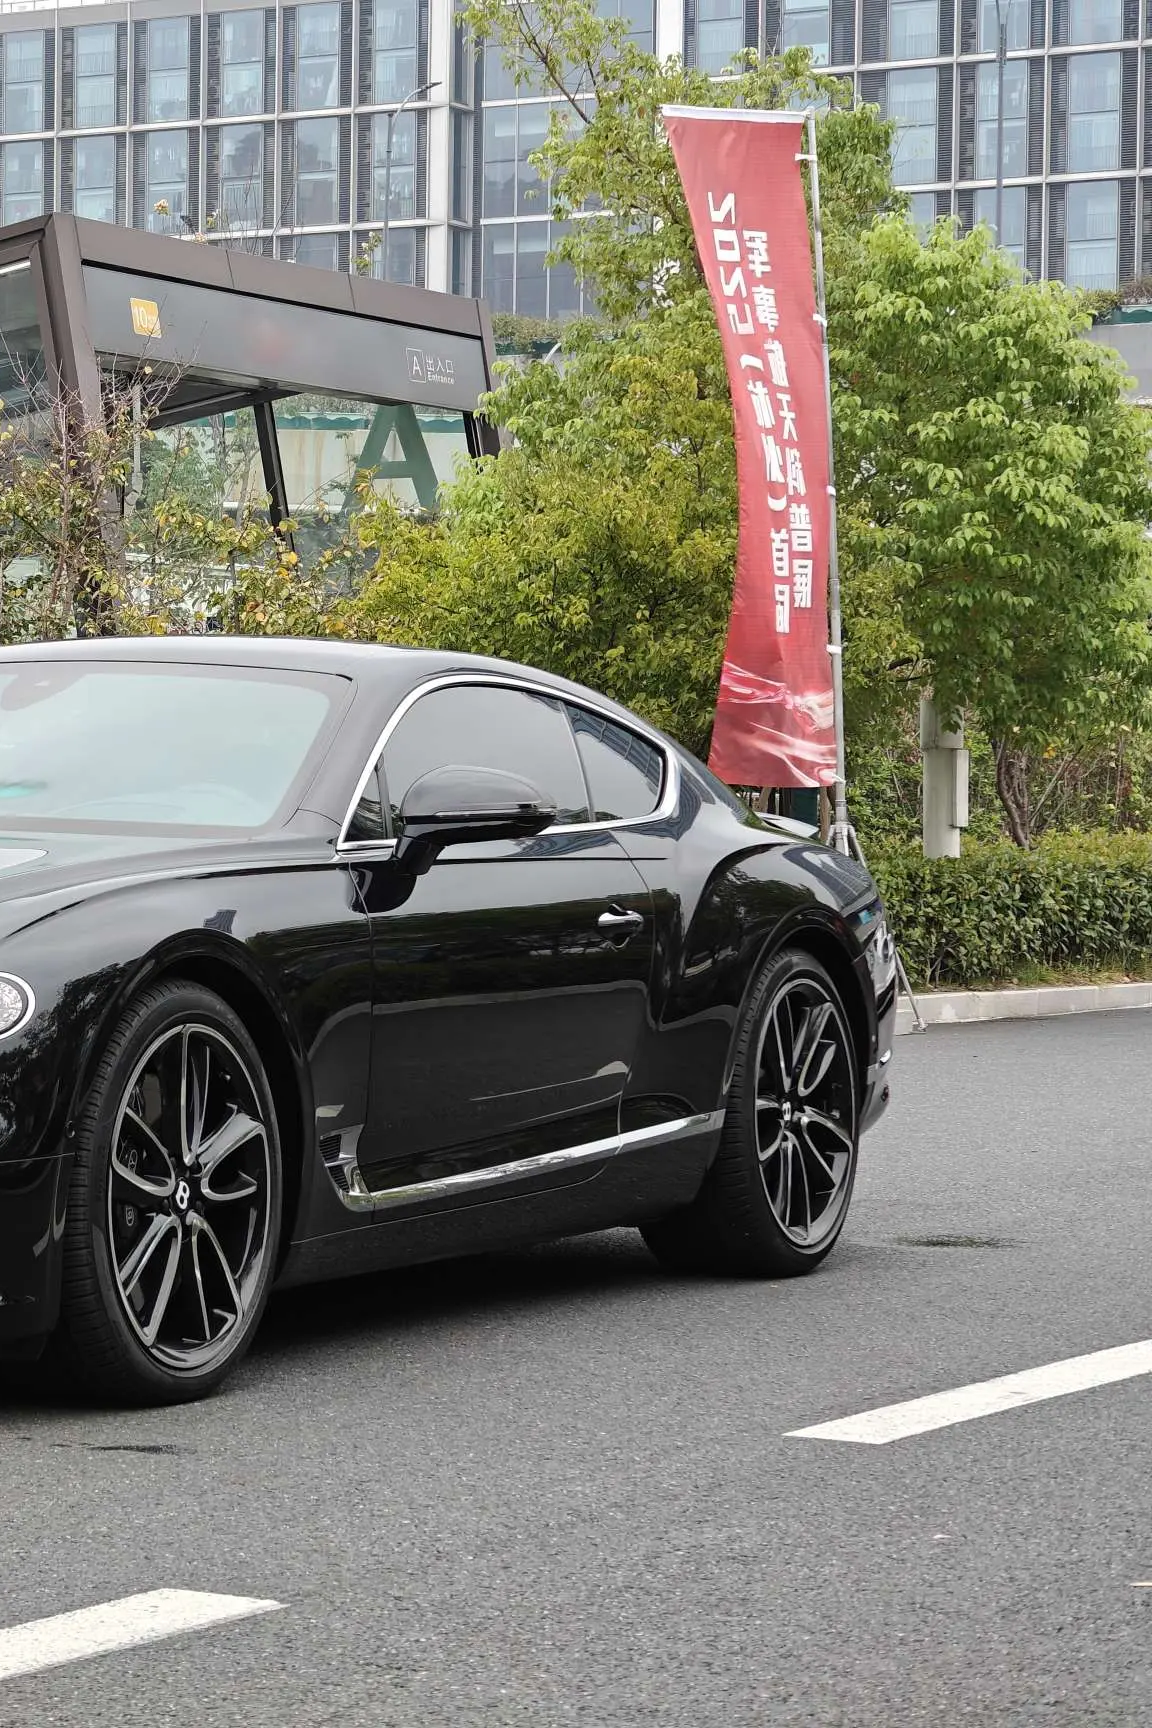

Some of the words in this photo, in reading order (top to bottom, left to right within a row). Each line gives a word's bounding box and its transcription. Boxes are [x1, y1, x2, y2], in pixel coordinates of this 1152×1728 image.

[412, 355, 423, 376] A
[426, 355, 455, 373] 出入口
[428, 371, 455, 384] Entrance
